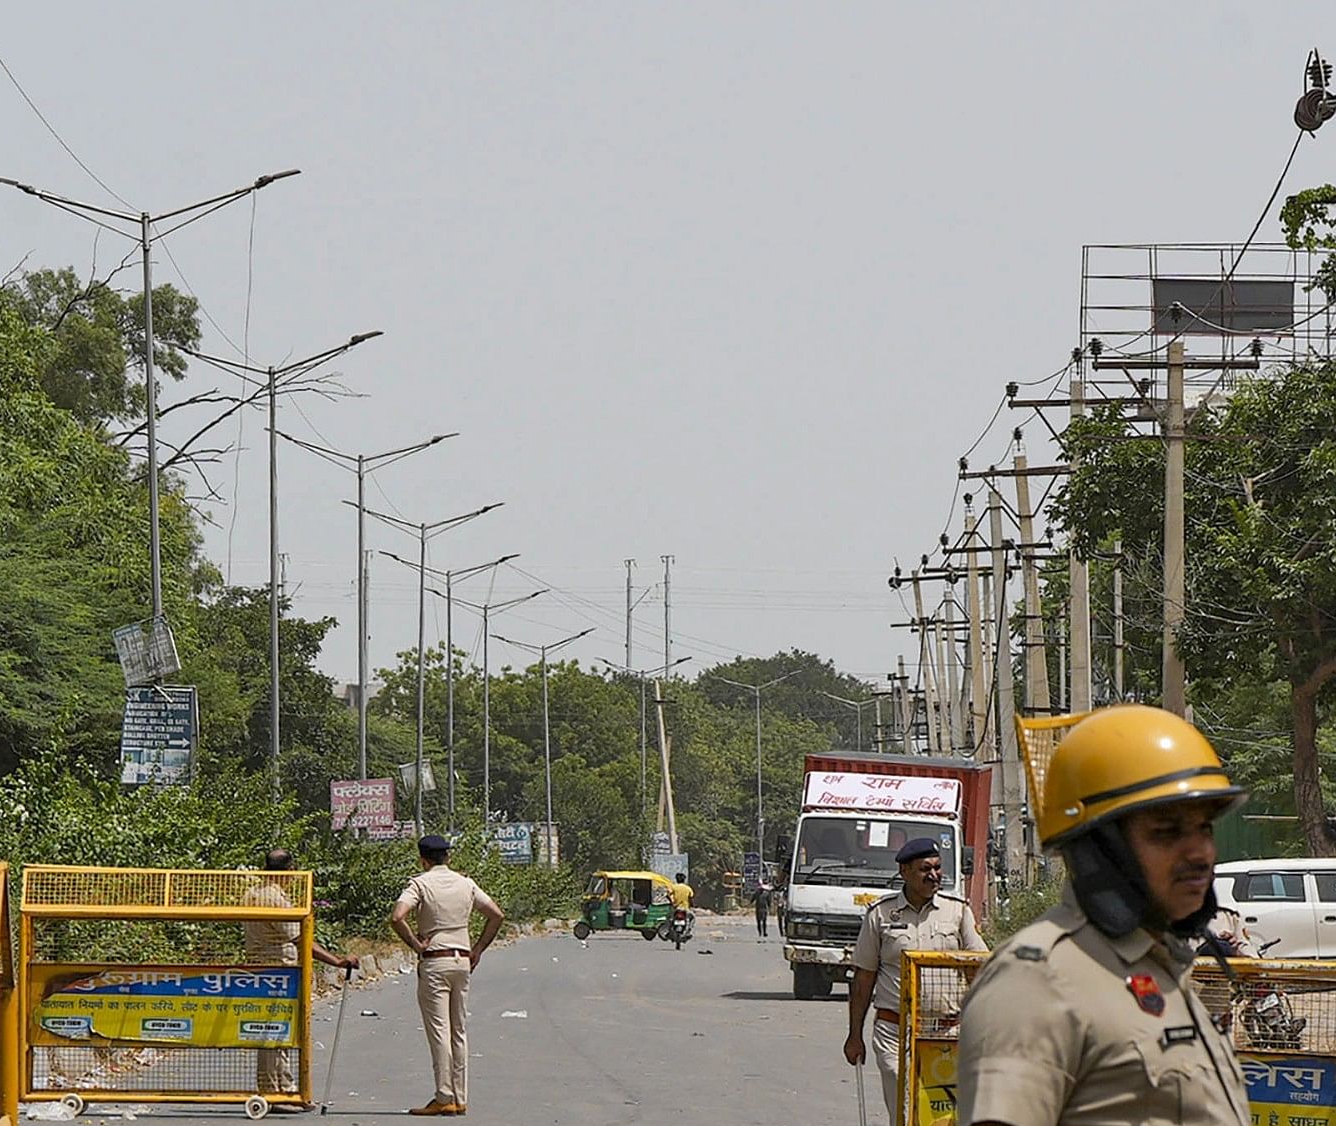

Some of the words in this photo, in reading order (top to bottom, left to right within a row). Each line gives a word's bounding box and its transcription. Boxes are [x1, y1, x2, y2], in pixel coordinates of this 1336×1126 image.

[861, 776, 906, 790] राम
[201, 967, 290, 993] पुलिस
[1289, 1090, 1320, 1102] सहयोग
